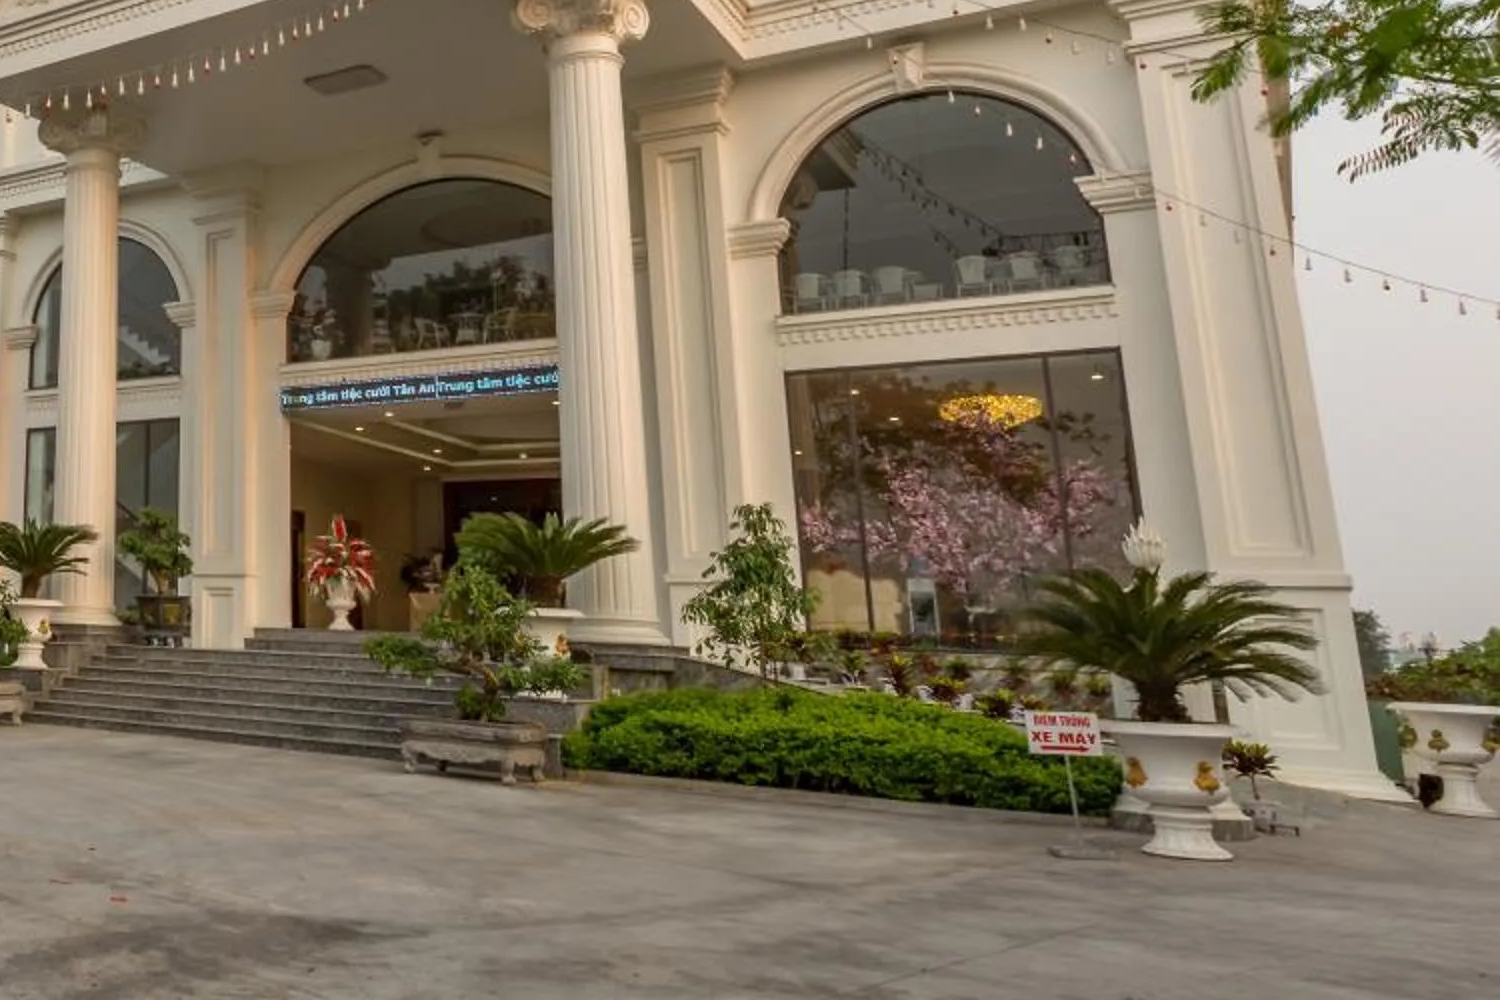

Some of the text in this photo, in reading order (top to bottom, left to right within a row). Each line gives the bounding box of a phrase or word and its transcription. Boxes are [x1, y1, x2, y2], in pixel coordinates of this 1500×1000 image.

[282, 394, 314, 406] Trng
[439, 380, 474, 393] Trung
[476, 376, 503, 390] tâm
[1031, 731, 1053, 743] XE
